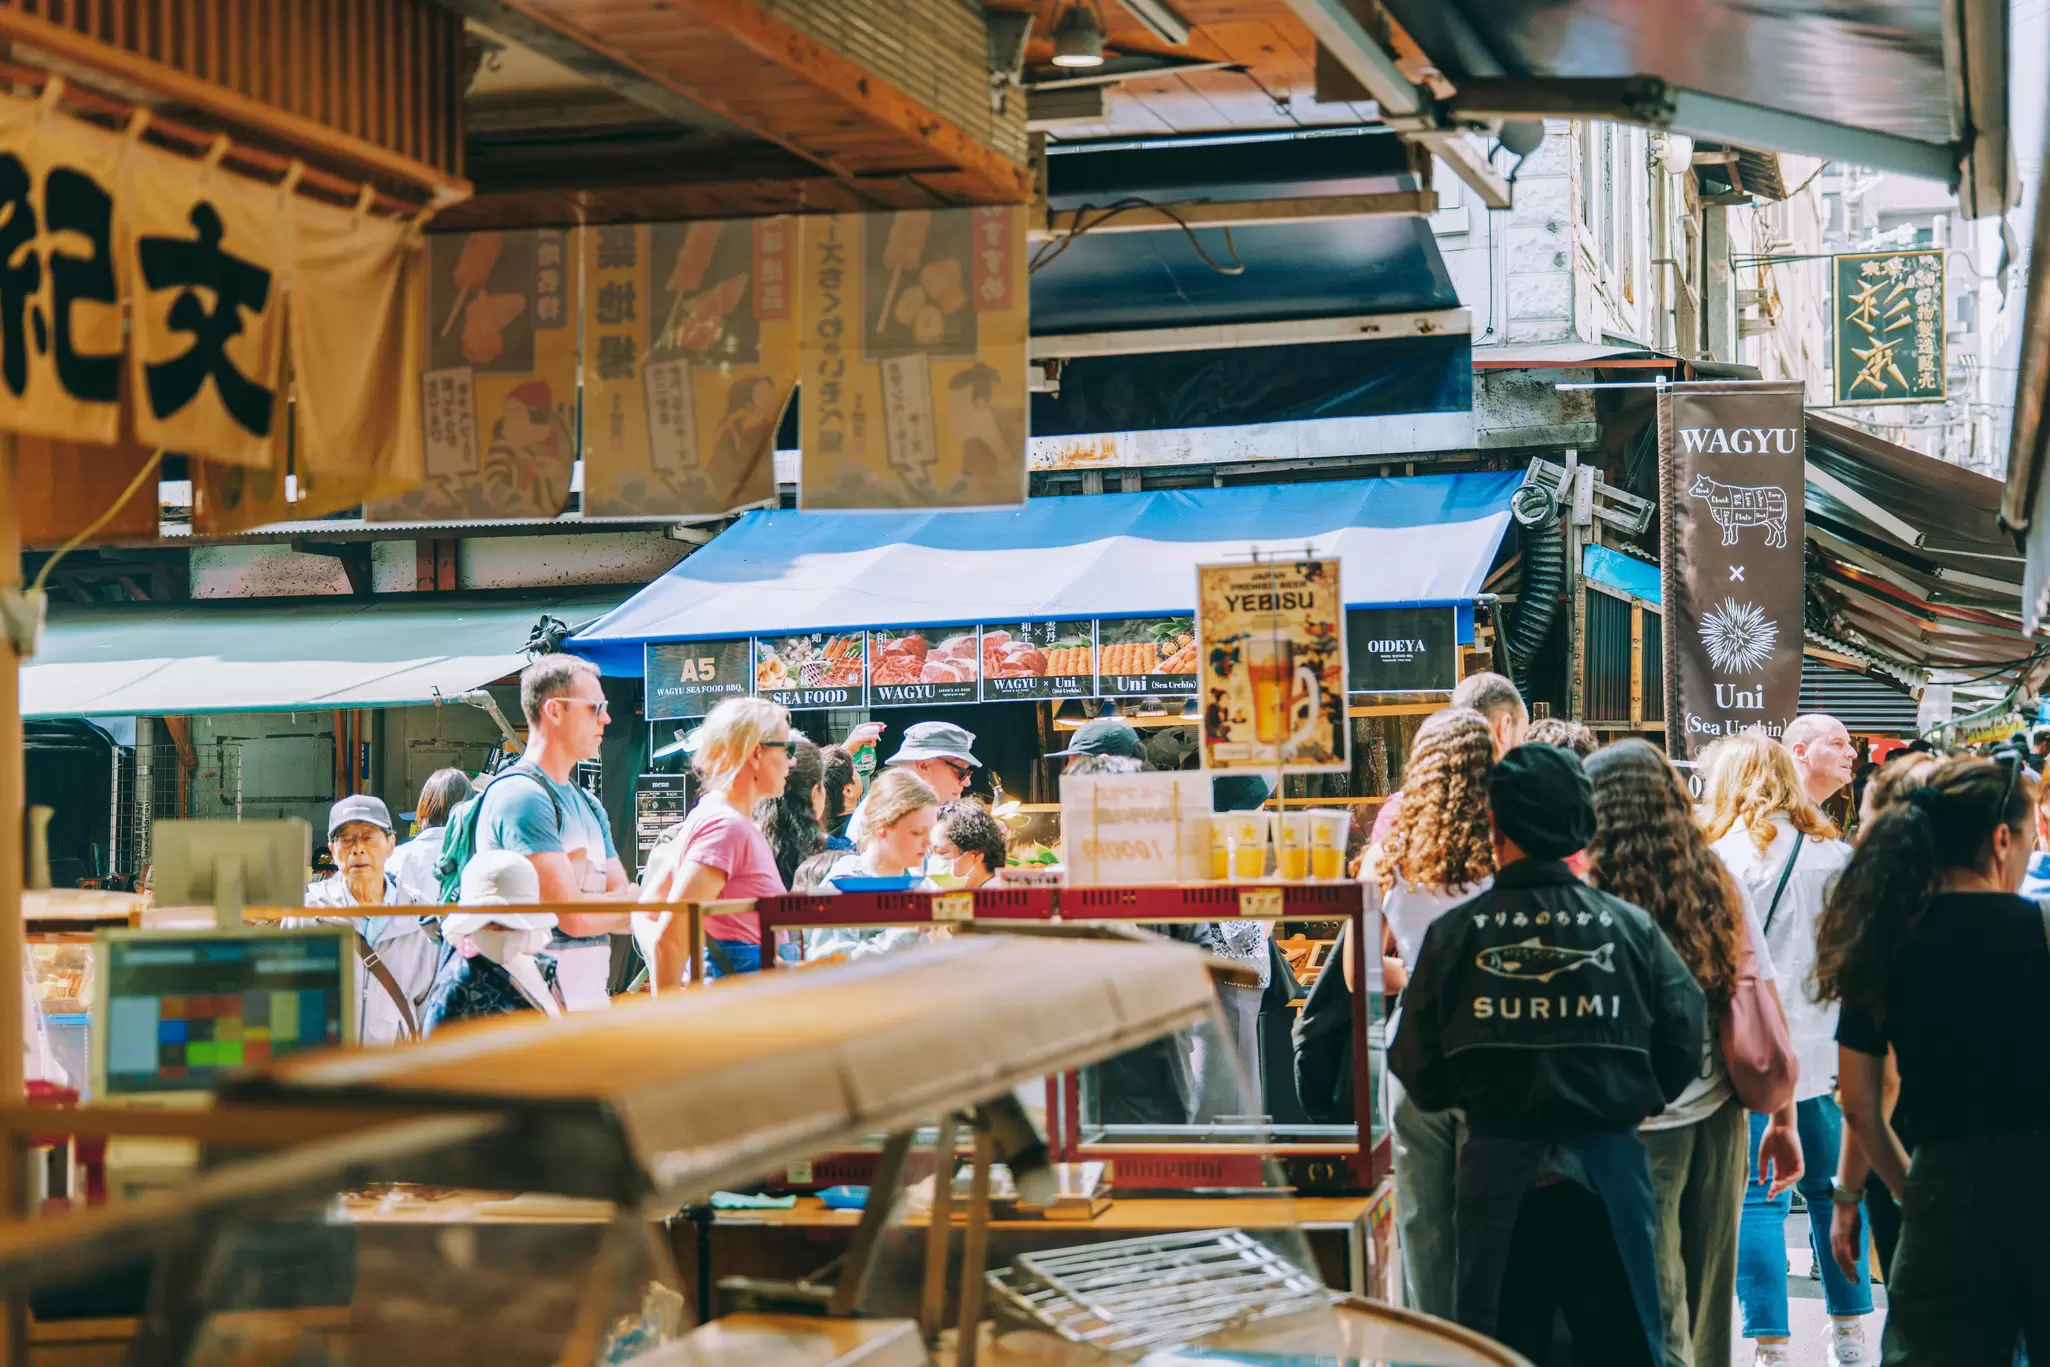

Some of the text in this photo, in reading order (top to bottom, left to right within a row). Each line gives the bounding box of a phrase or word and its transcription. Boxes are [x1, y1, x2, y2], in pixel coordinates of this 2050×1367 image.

[0, 150, 275, 438] 紀文
[1679, 428, 1798, 454] WAGYU
[1225, 591, 1314, 612] YEBISU
[1021, 622, 1032, 643] 和牛
[876, 632, 887, 656] 和牛
[1367, 639, 1426, 652] OIDEYA
[680, 657, 716, 682] A5
[657, 686, 685, 696] WAGYU
[701, 684, 724, 693] FOOD
[878, 685, 936, 700] WAGYU
[994, 678, 1037, 690] WAGYU
[1055, 677, 1076, 688] Uni
[1117, 676, 1197, 691] Uni (Sea Urchin)
[773, 689, 848, 705] SEA FOOD
[1714, 683, 1765, 709] Uni
[1685, 712, 1787, 737] (Sea Urhin)
[1473, 994, 1620, 1020] SURIMI
